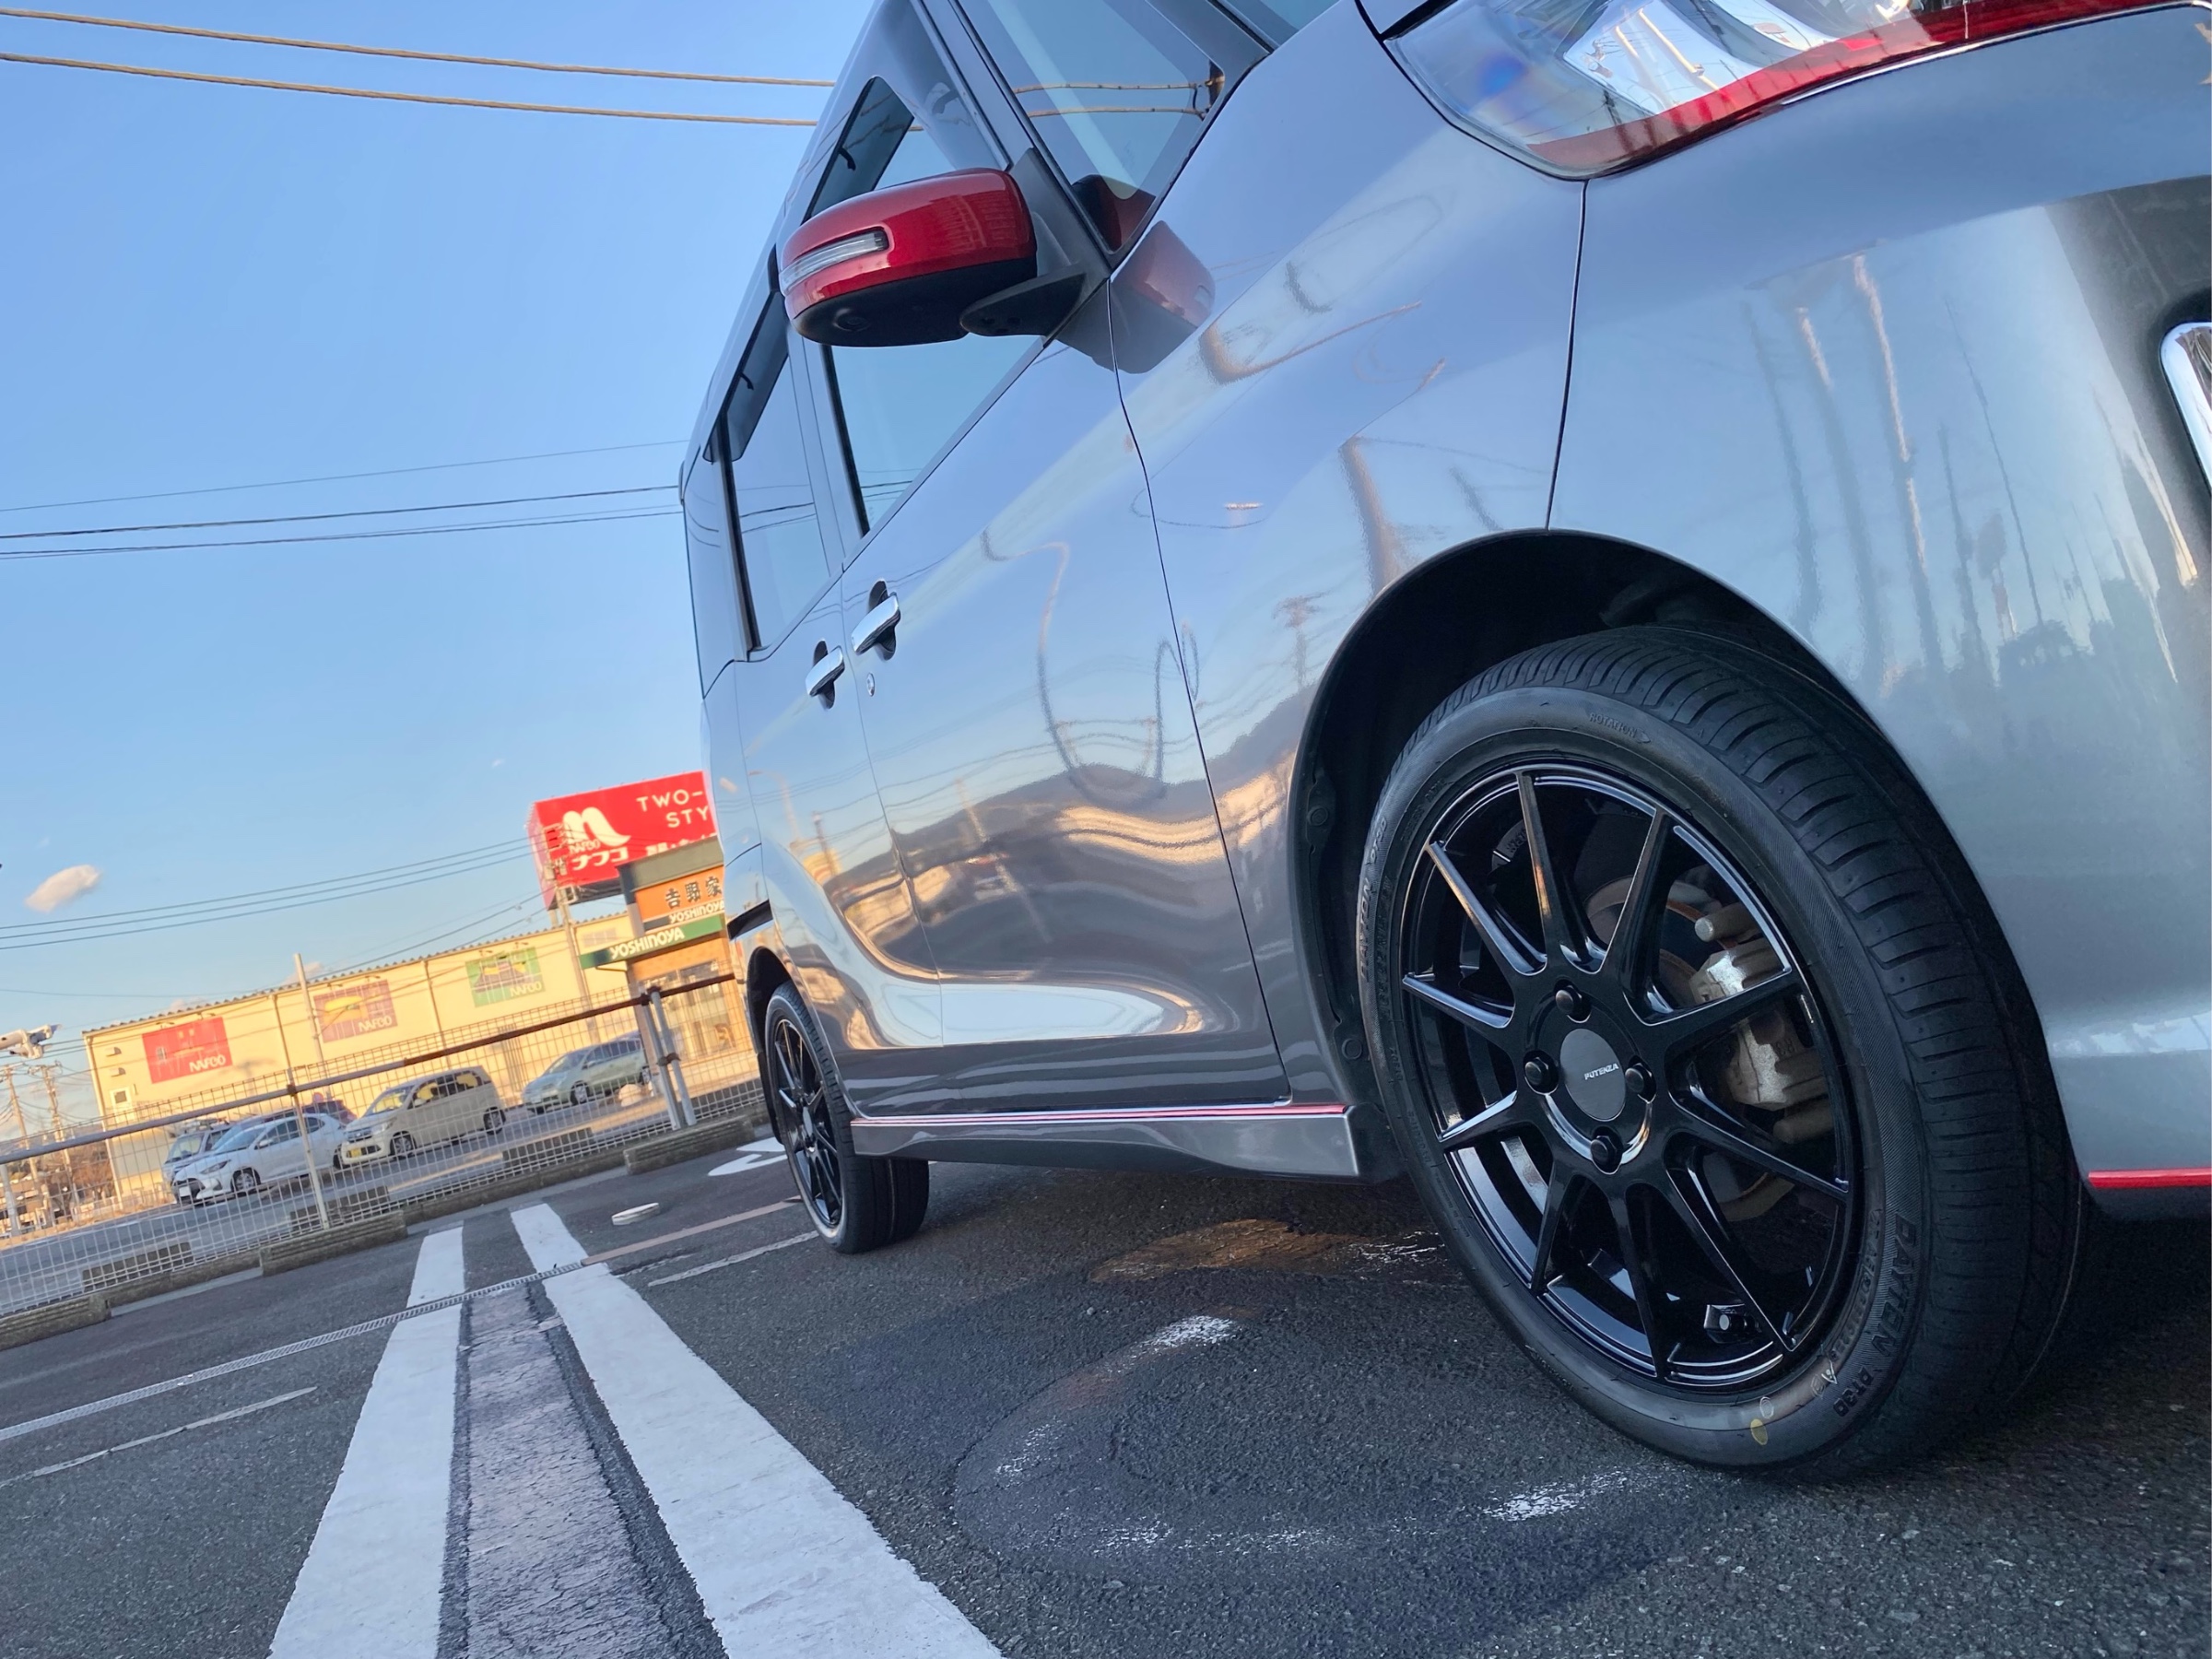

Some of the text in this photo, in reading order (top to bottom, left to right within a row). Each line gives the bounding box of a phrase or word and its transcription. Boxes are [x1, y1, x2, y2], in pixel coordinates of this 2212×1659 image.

[1589, 712, 1638, 738] ROTATION
[636, 788, 703, 812] TWO-
[666, 805, 709, 829] STY
[571, 846, 629, 871] ナフコ
[665, 876, 723, 910] 吉野家
[609, 926, 686, 960] YOSHINOYA
[358, 1015, 393, 1032] NAFCO
[189, 1054, 227, 1073] NAFCO
[1583, 1063, 1619, 1080] POTENZA
[1871, 1212, 1916, 1357] DAYTON
[1833, 1367, 1874, 1418] DT30
